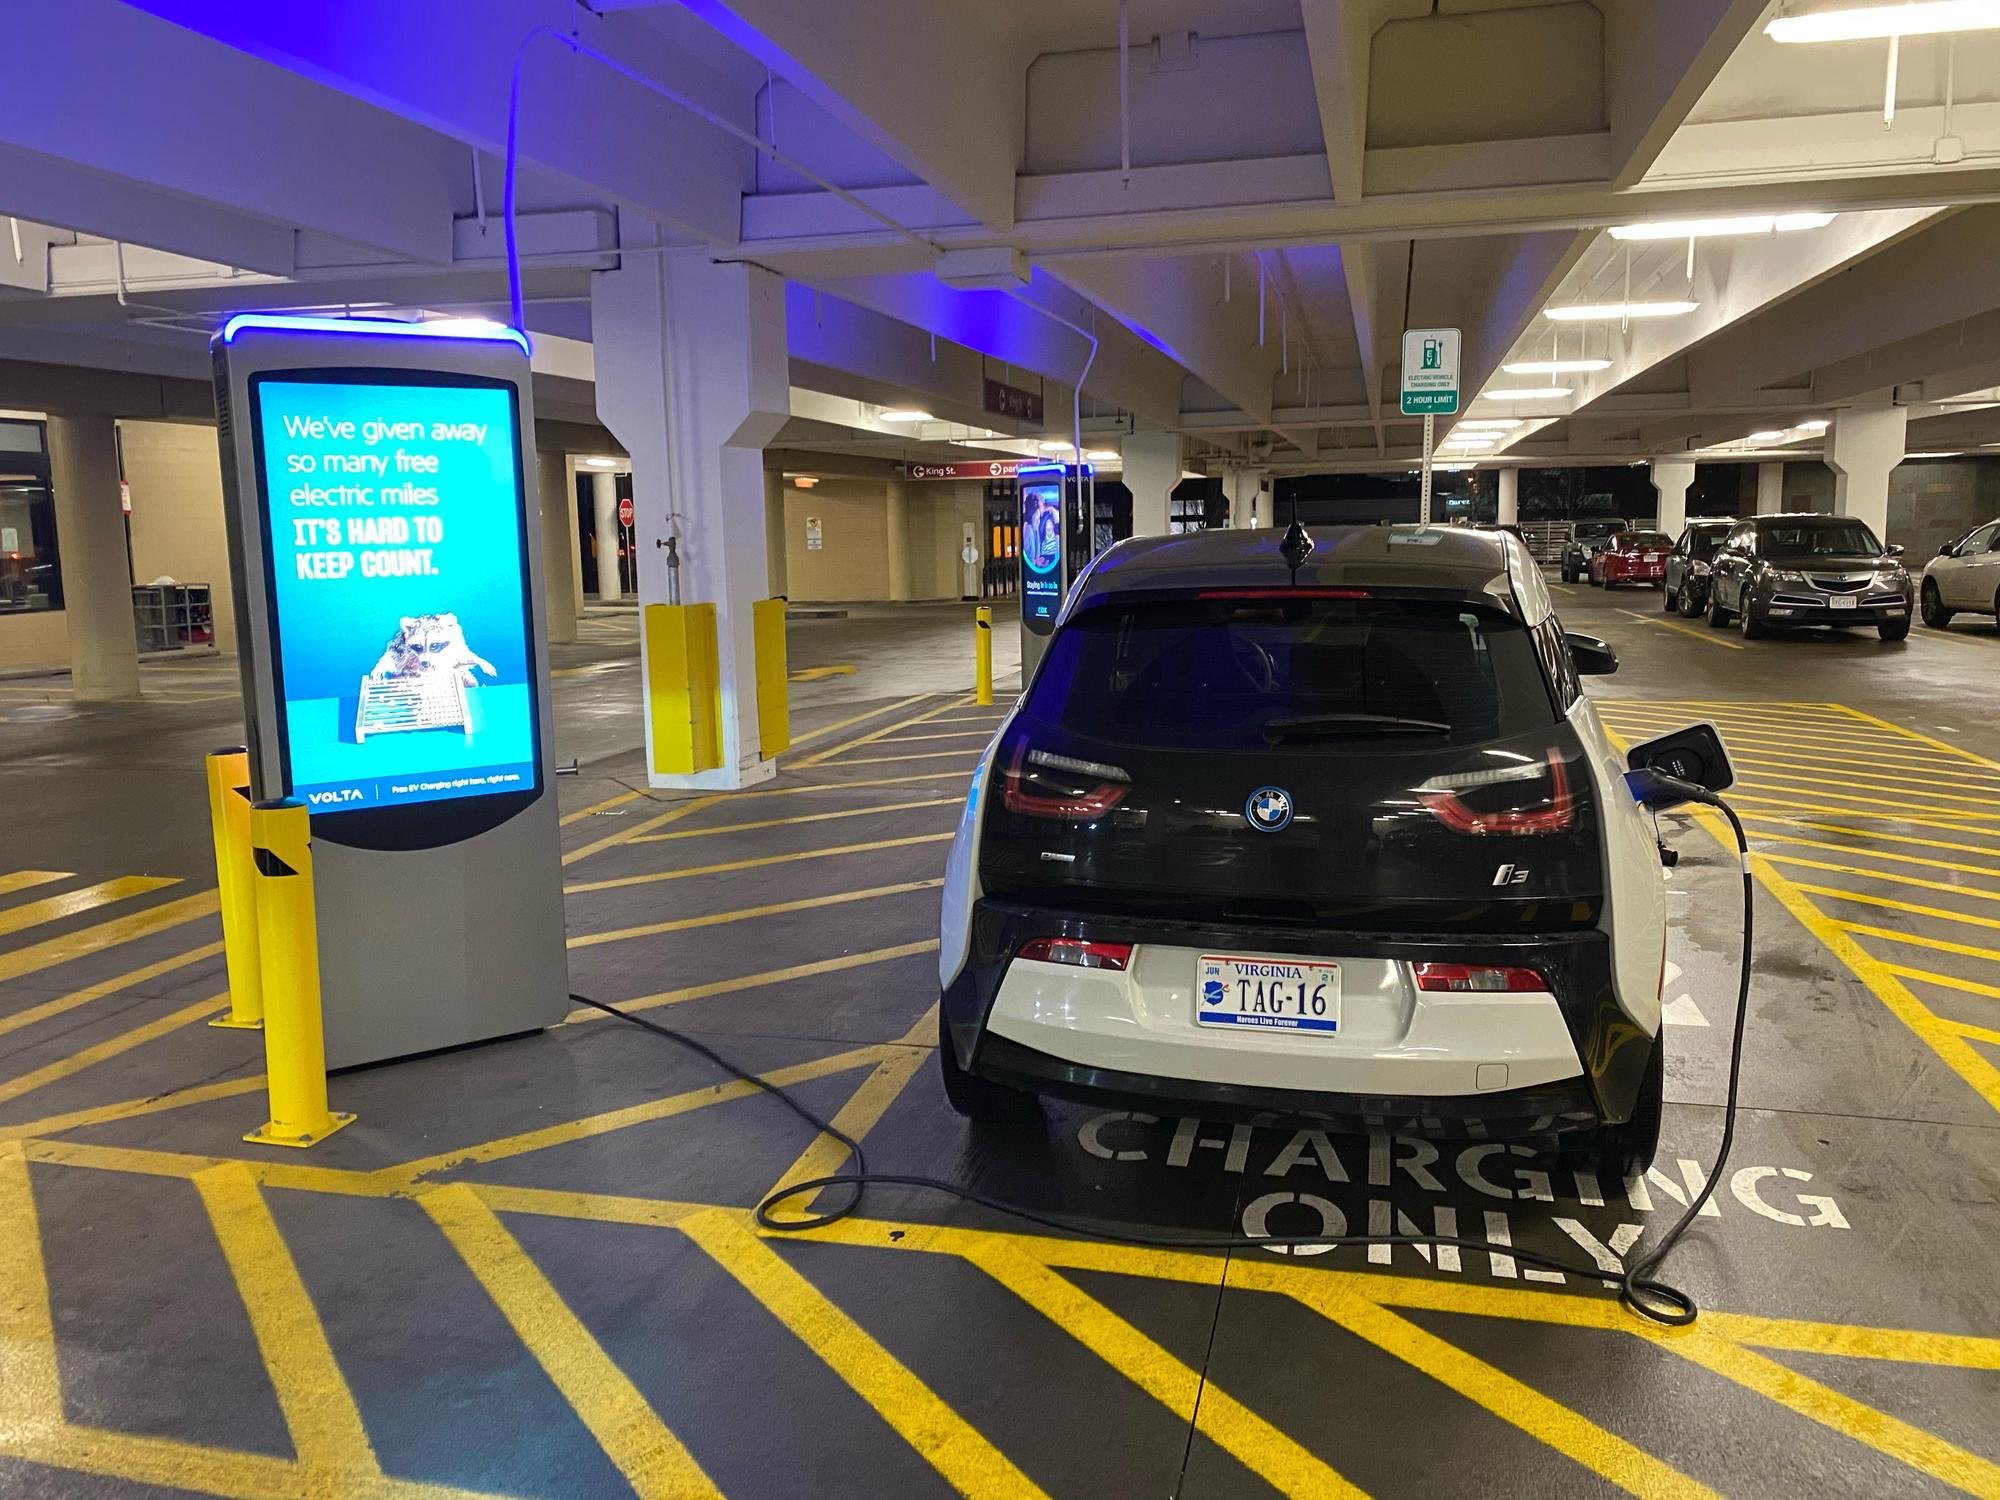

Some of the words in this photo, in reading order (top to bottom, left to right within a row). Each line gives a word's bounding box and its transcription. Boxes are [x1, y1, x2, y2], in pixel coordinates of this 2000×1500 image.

[1413, 396, 1432, 404] HOUR
[1433, 395, 1453, 404] LIMIT
[283, 414, 356, 440] We've
[362, 416, 425, 445] given
[430, 422, 488, 447] away
[287, 453, 317, 473] so
[323, 453, 389, 479] many
[394, 448, 439, 473] free
[926, 467, 944, 477] King
[945, 466, 956, 475] St.
[289, 482, 374, 507] electric
[380, 481, 439, 506] miles
[620, 507, 633, 519] STOP
[293, 517, 342, 546] IT'S
[347, 516, 408, 545] HARD
[413, 516, 443, 544] TO
[295, 551, 354, 580] KEEP
[360, 548, 439, 578] COUNT.
[392, 785, 408, 794] Free
[408, 784, 419, 793] EV
[420, 781, 451, 792] Charging
[451, 778, 469, 788] right
[487, 775, 503, 784] right
[308, 788, 364, 805] VOLTA
[1492, 864, 1530, 886] i3
[1205, 966, 1220, 976] JUN
[1235, 964, 1302, 979] VIRGINIA
[1237, 979, 1327, 1016] TAG-16
[1236, 1015, 1259, 1024] Heroes
[1260, 1016, 1273, 1026] Live
[1274, 1018, 1298, 1028] Forever
[1241, 1191, 1645, 1291] ONLY
